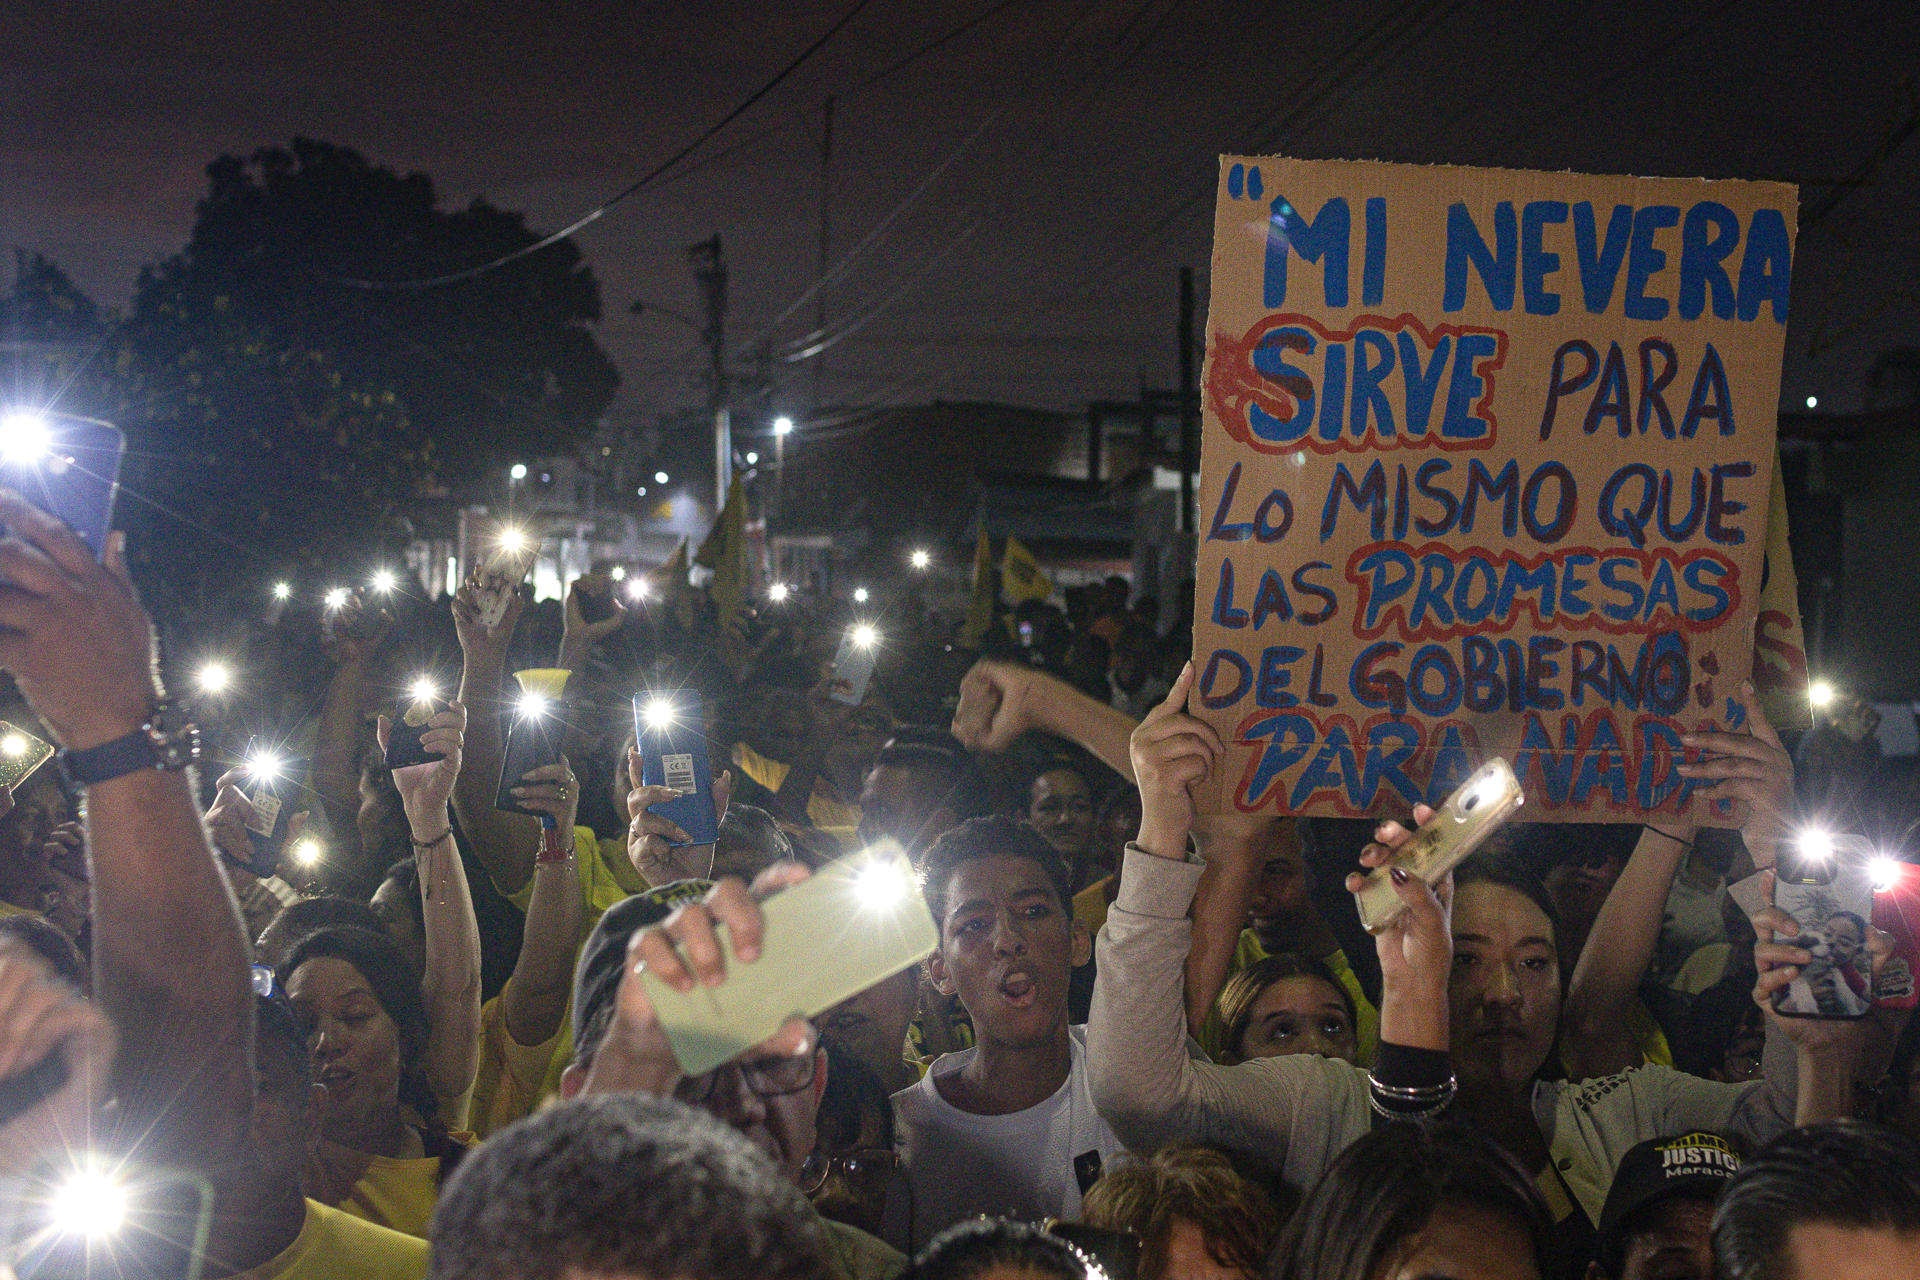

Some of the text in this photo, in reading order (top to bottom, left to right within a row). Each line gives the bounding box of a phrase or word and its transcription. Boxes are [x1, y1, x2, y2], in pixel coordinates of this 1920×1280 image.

[1443, 200, 1789, 325] NEVERA
[1248, 326, 1735, 441] SIRVE PARA
[1320, 458, 1577, 544] MISMO
[1598, 461, 1756, 548] QUE
[1212, 549, 1730, 631] LAS PROMESAS
[1200, 643, 1338, 709] DEL
